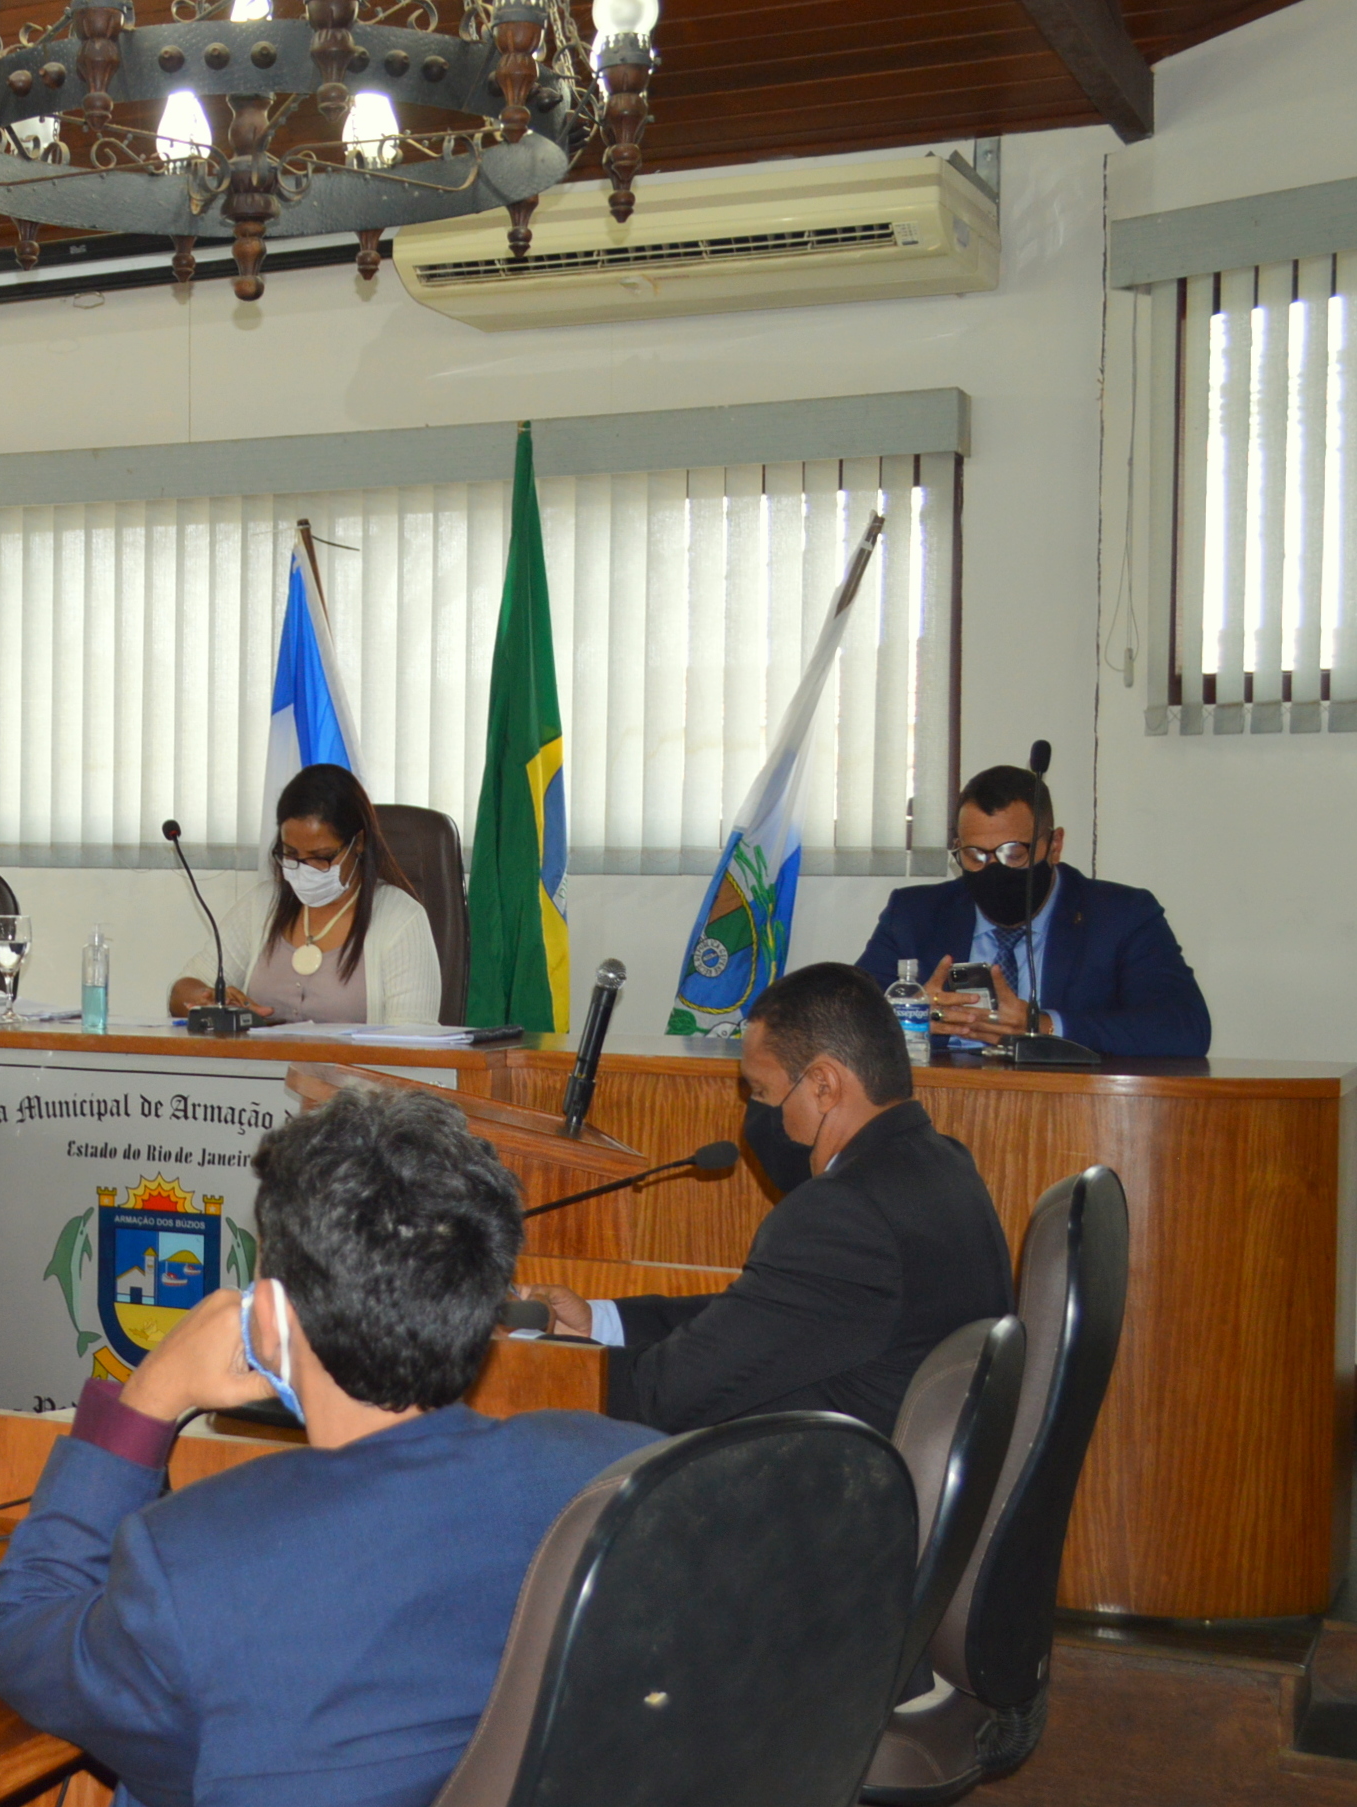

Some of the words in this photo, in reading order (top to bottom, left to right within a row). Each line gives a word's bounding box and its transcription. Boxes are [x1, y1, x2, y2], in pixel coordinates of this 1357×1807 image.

[16, 1093, 131, 1123] Municipal
[140, 1094, 164, 1118] de
[169, 1094, 273, 1135] Armação
[67, 1140, 117, 1159] Estado
[122, 1143, 141, 1160] do
[146, 1144, 172, 1163] Rio
[174, 1146, 193, 1164] de
[197, 1148, 251, 1167] Janeir
[114, 1215, 155, 1226] ARMAÇÃO
[156, 1218, 173, 1227] DOS
[175, 1218, 205, 1229] BÚZIOS
